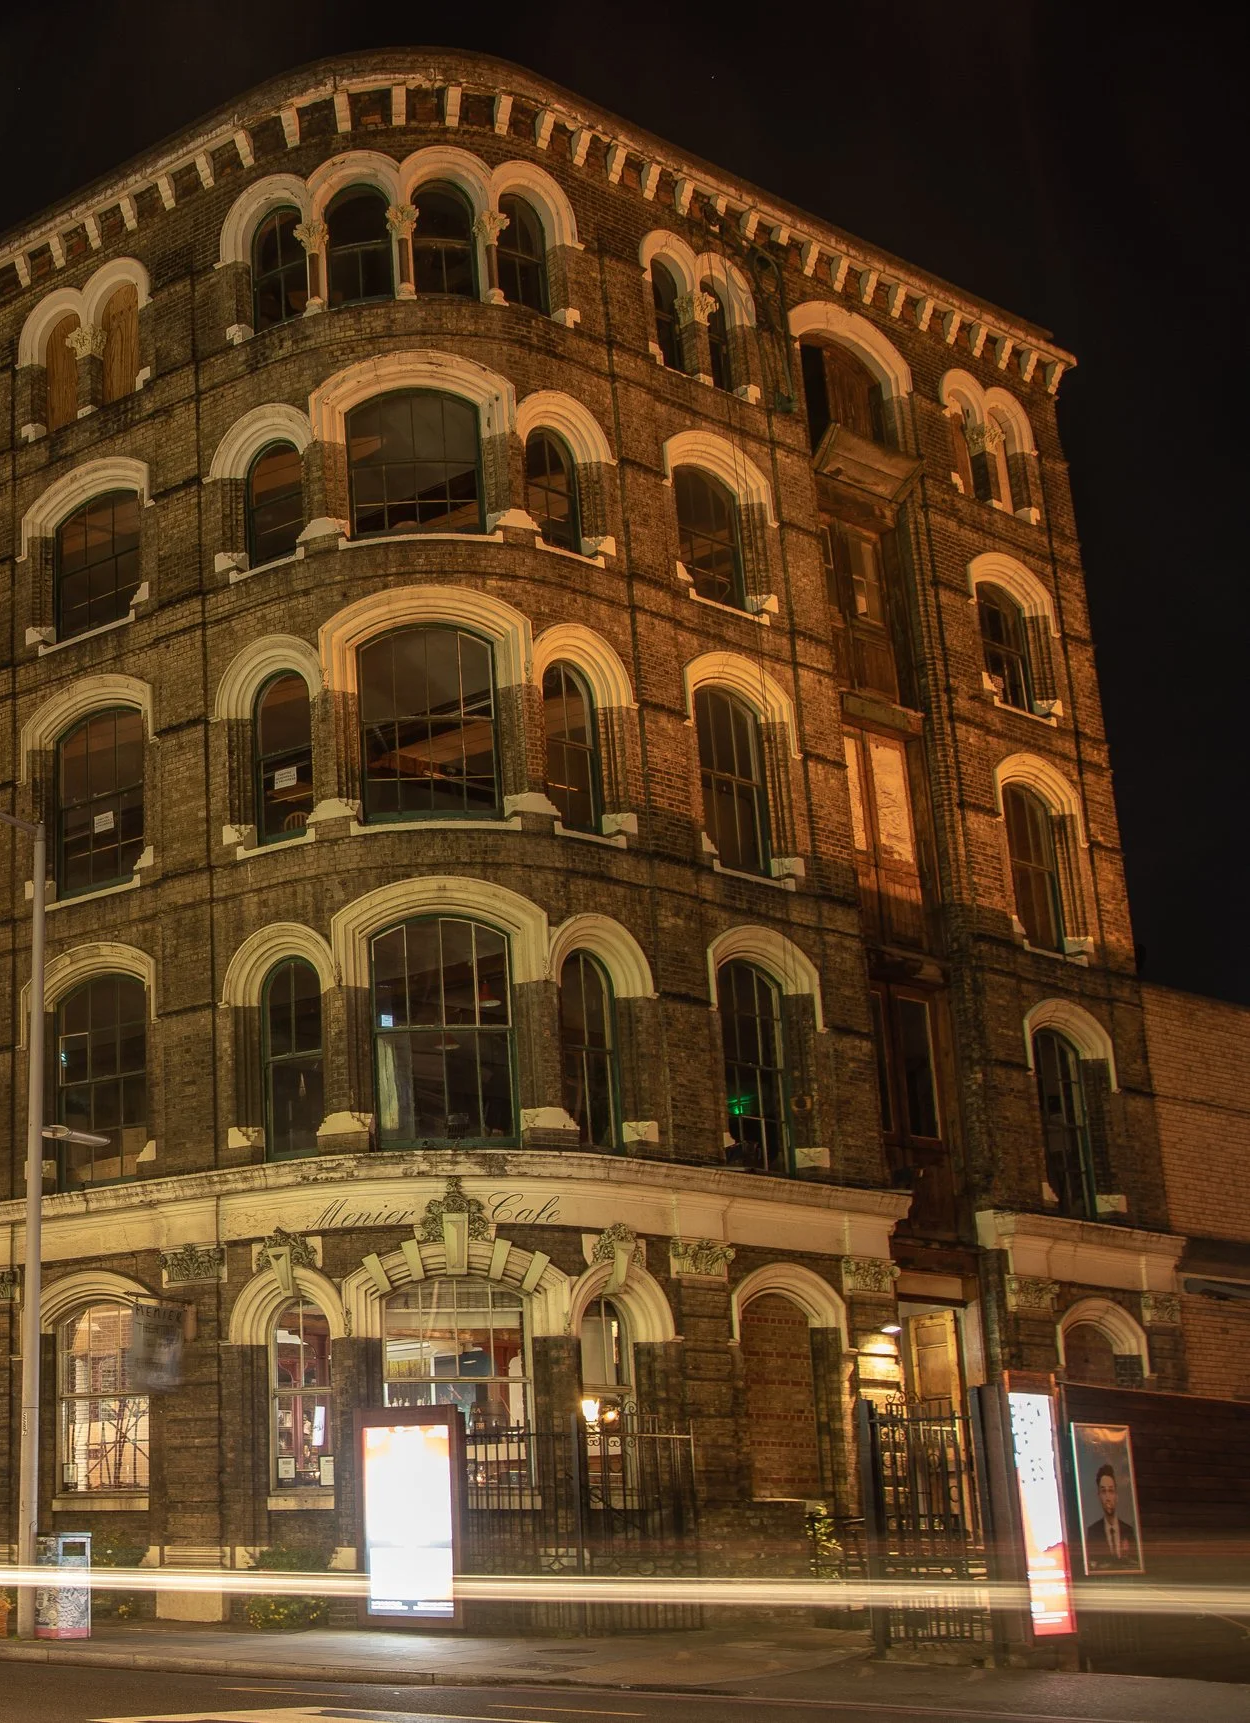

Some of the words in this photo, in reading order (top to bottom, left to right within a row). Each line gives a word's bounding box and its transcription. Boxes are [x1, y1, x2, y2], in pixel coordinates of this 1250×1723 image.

[305, 1198, 417, 1230] Menier
[487, 1191, 561, 1224] Cafe
[135, 1305, 182, 1323] MENIER
